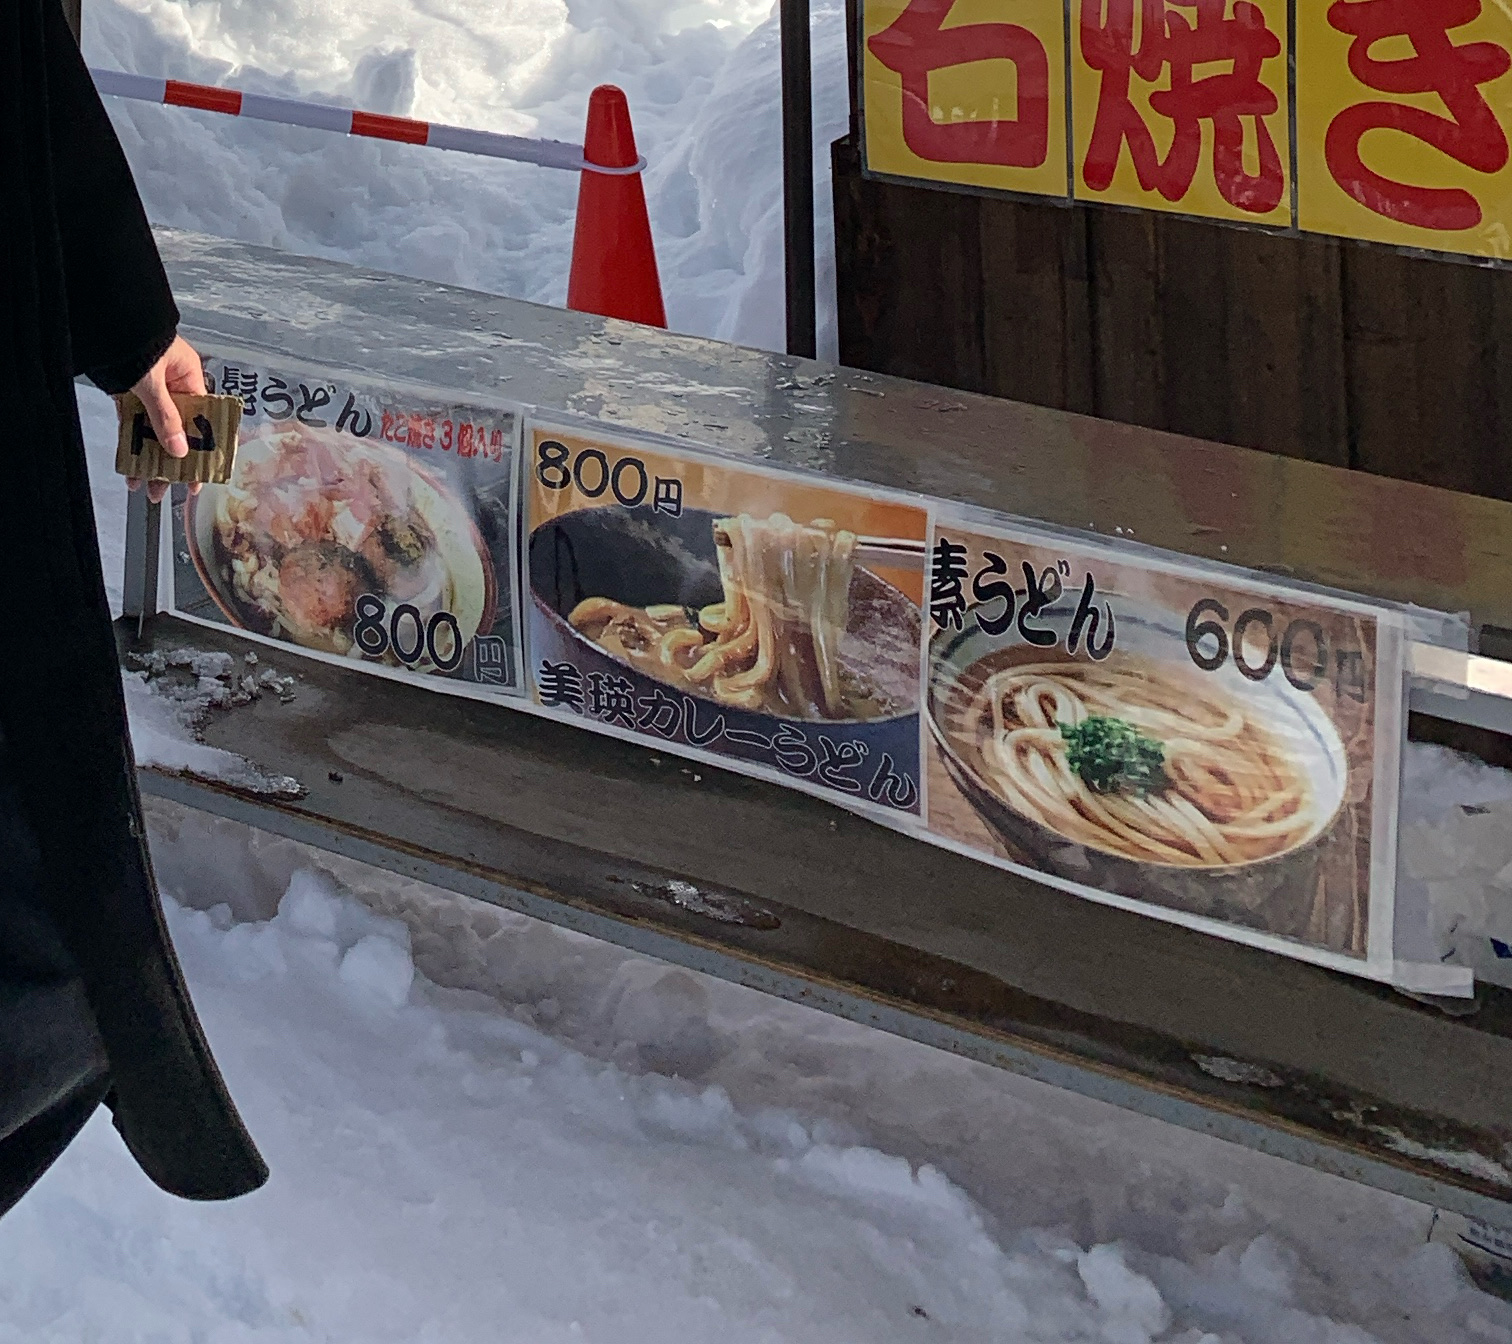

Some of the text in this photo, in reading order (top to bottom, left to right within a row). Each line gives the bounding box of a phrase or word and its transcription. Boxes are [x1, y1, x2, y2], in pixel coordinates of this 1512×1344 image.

[535, 441, 683, 518] 800円
[354, 594, 509, 687] 800円
[928, 538, 1115, 661] 素うどん
[538, 659, 918, 810] 美瑛カレーうどん
